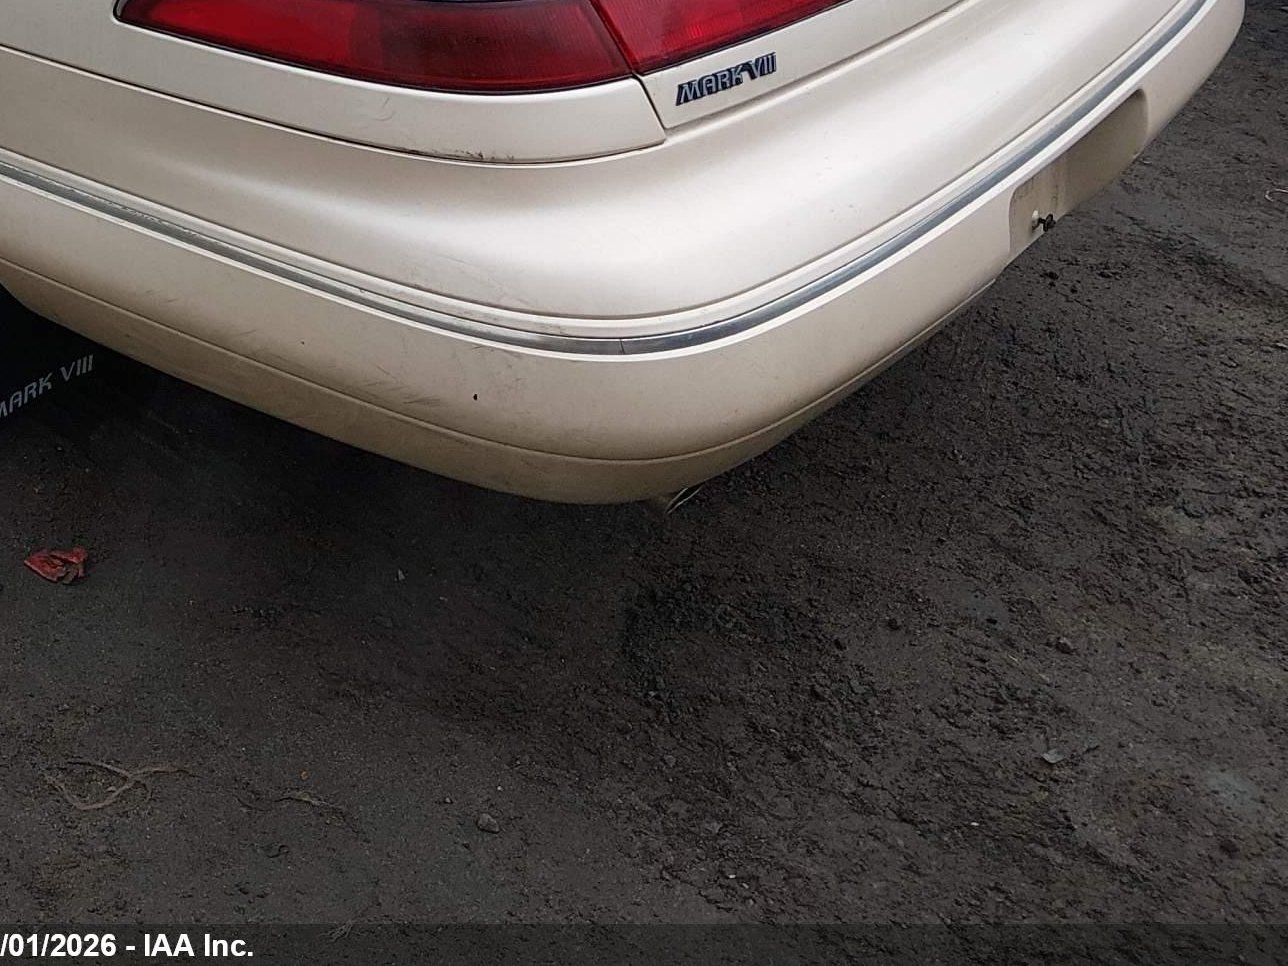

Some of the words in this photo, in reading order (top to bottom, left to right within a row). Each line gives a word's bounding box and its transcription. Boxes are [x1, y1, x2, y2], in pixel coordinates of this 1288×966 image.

[675, 66, 744, 106] MARK
[746, 52, 777, 81] VIII
[59, 354, 93, 381] VIII
